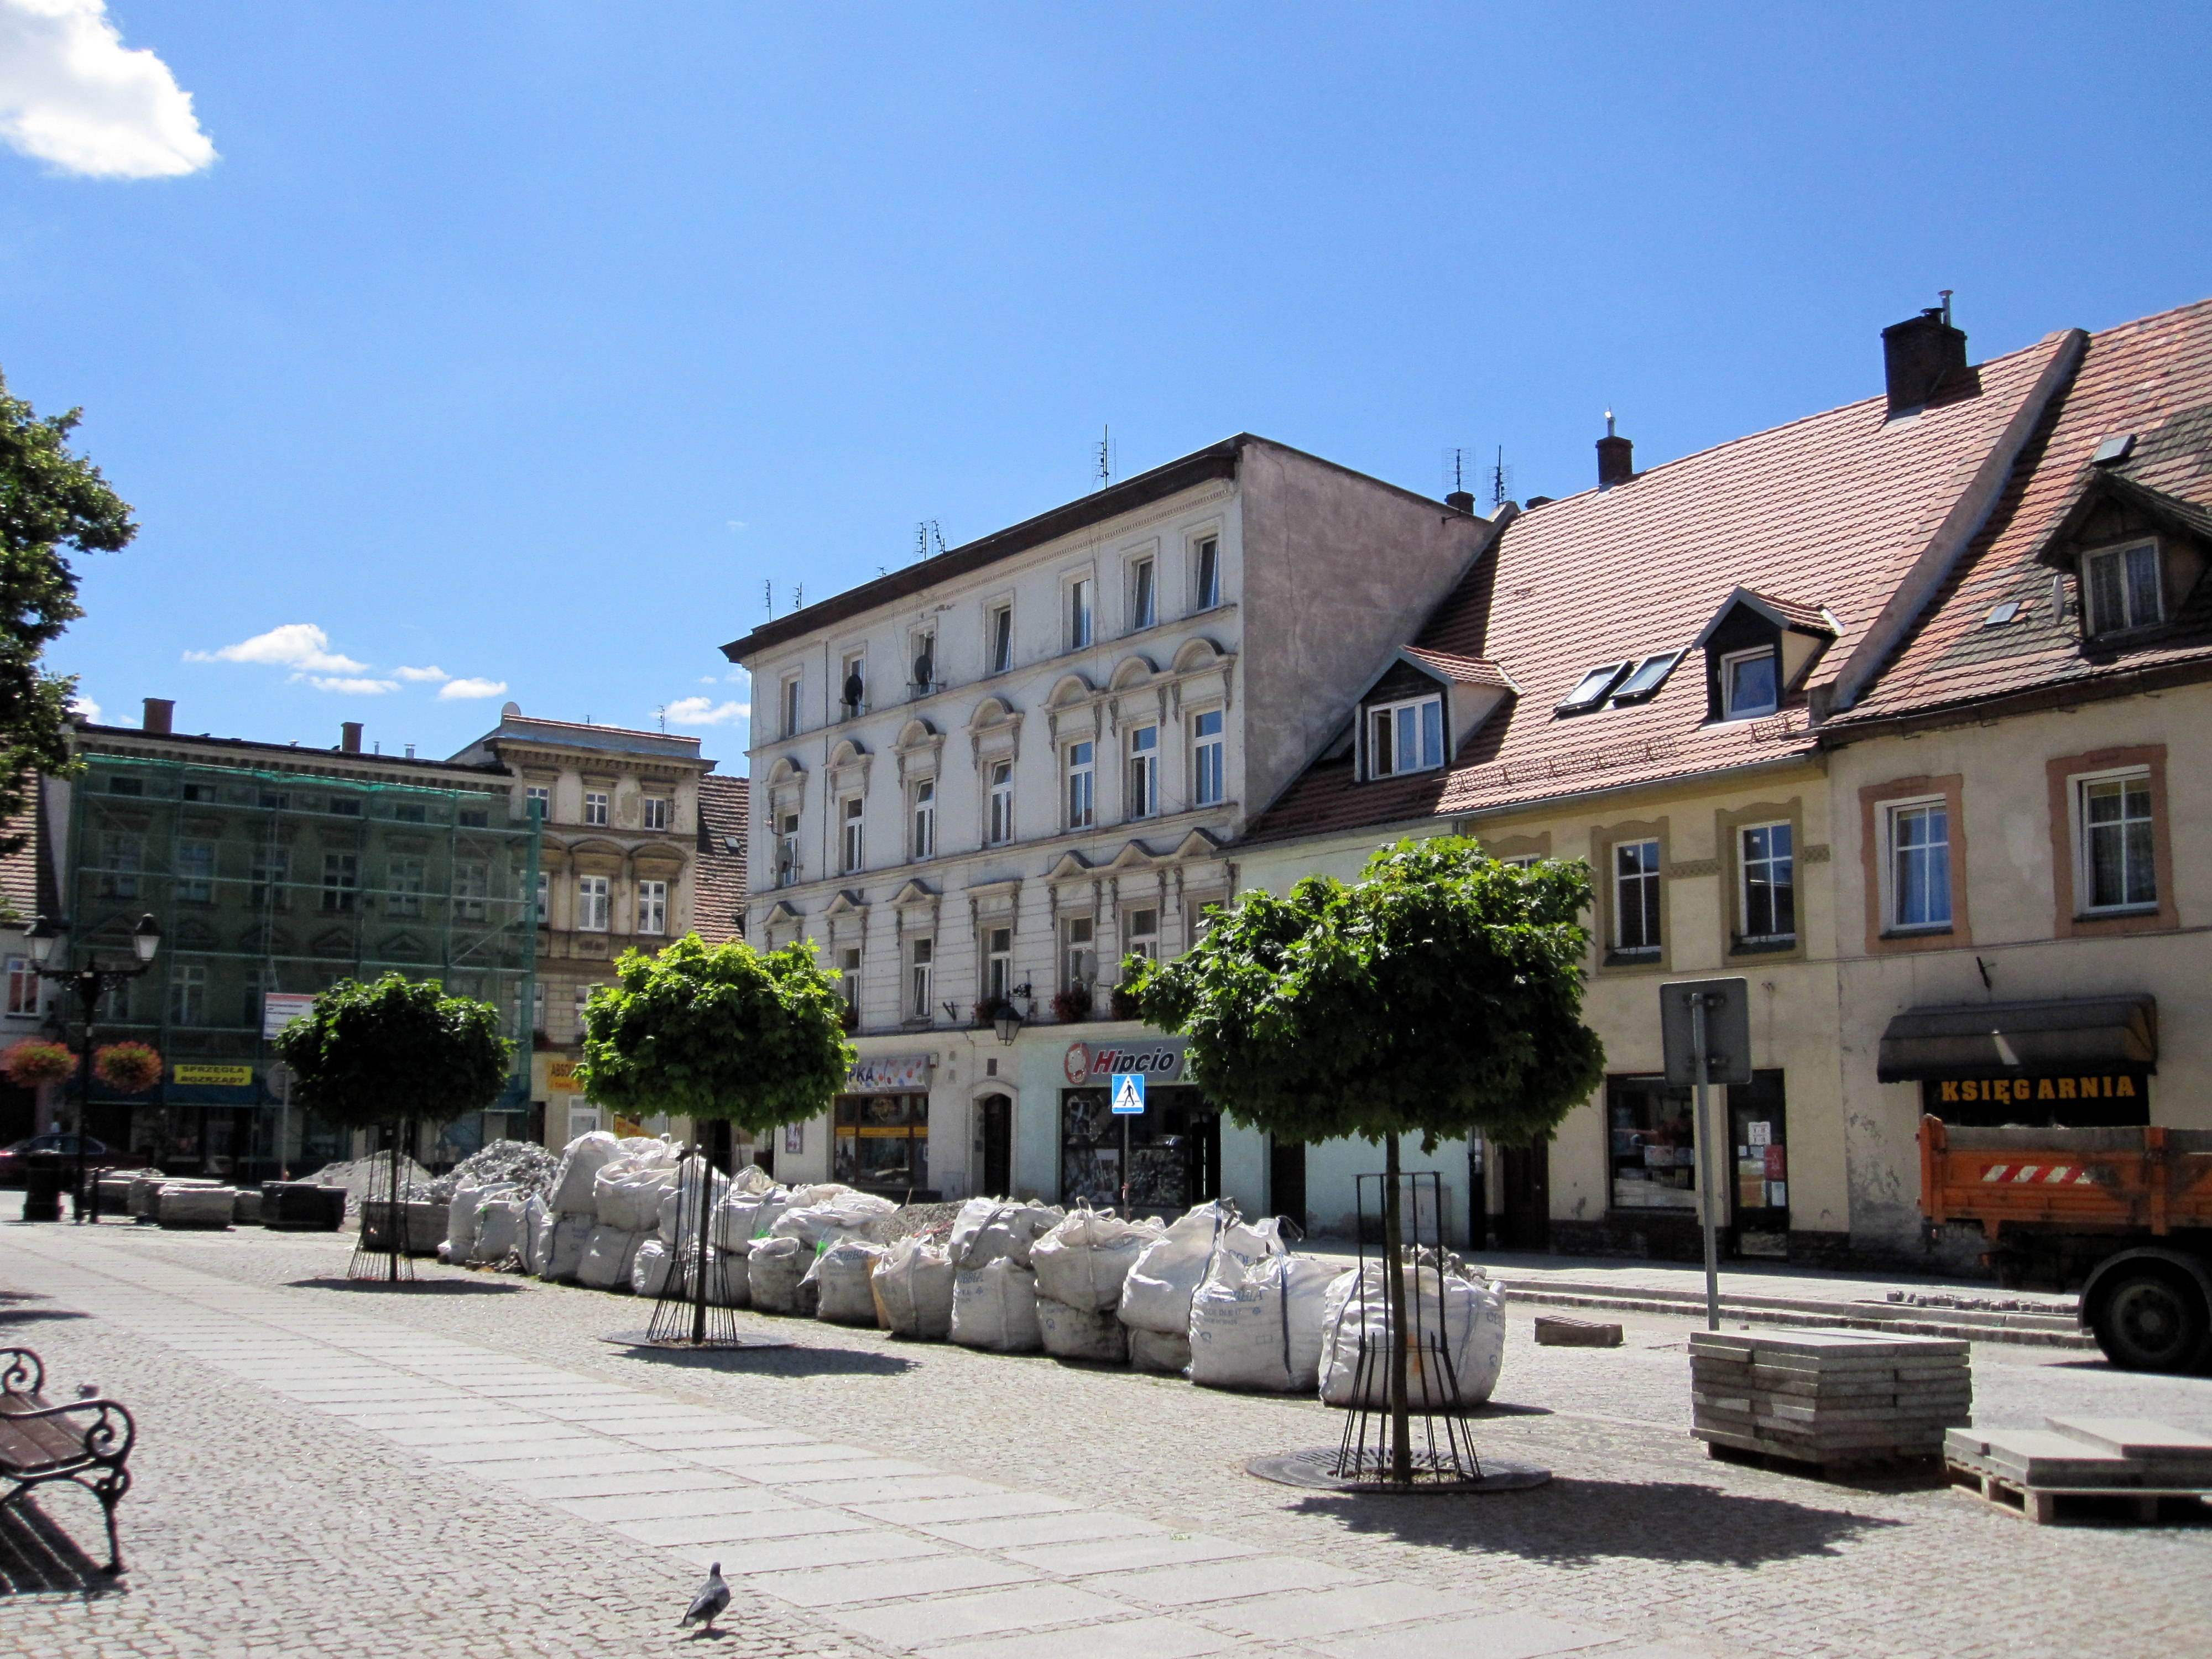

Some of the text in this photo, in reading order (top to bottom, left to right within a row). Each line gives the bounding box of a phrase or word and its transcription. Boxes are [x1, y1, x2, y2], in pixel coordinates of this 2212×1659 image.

[1092, 1047, 1175, 1074] Hipcio
[848, 1067, 874, 1082] PKA
[1942, 1076, 2136, 1104] KSIĘGARNIA
